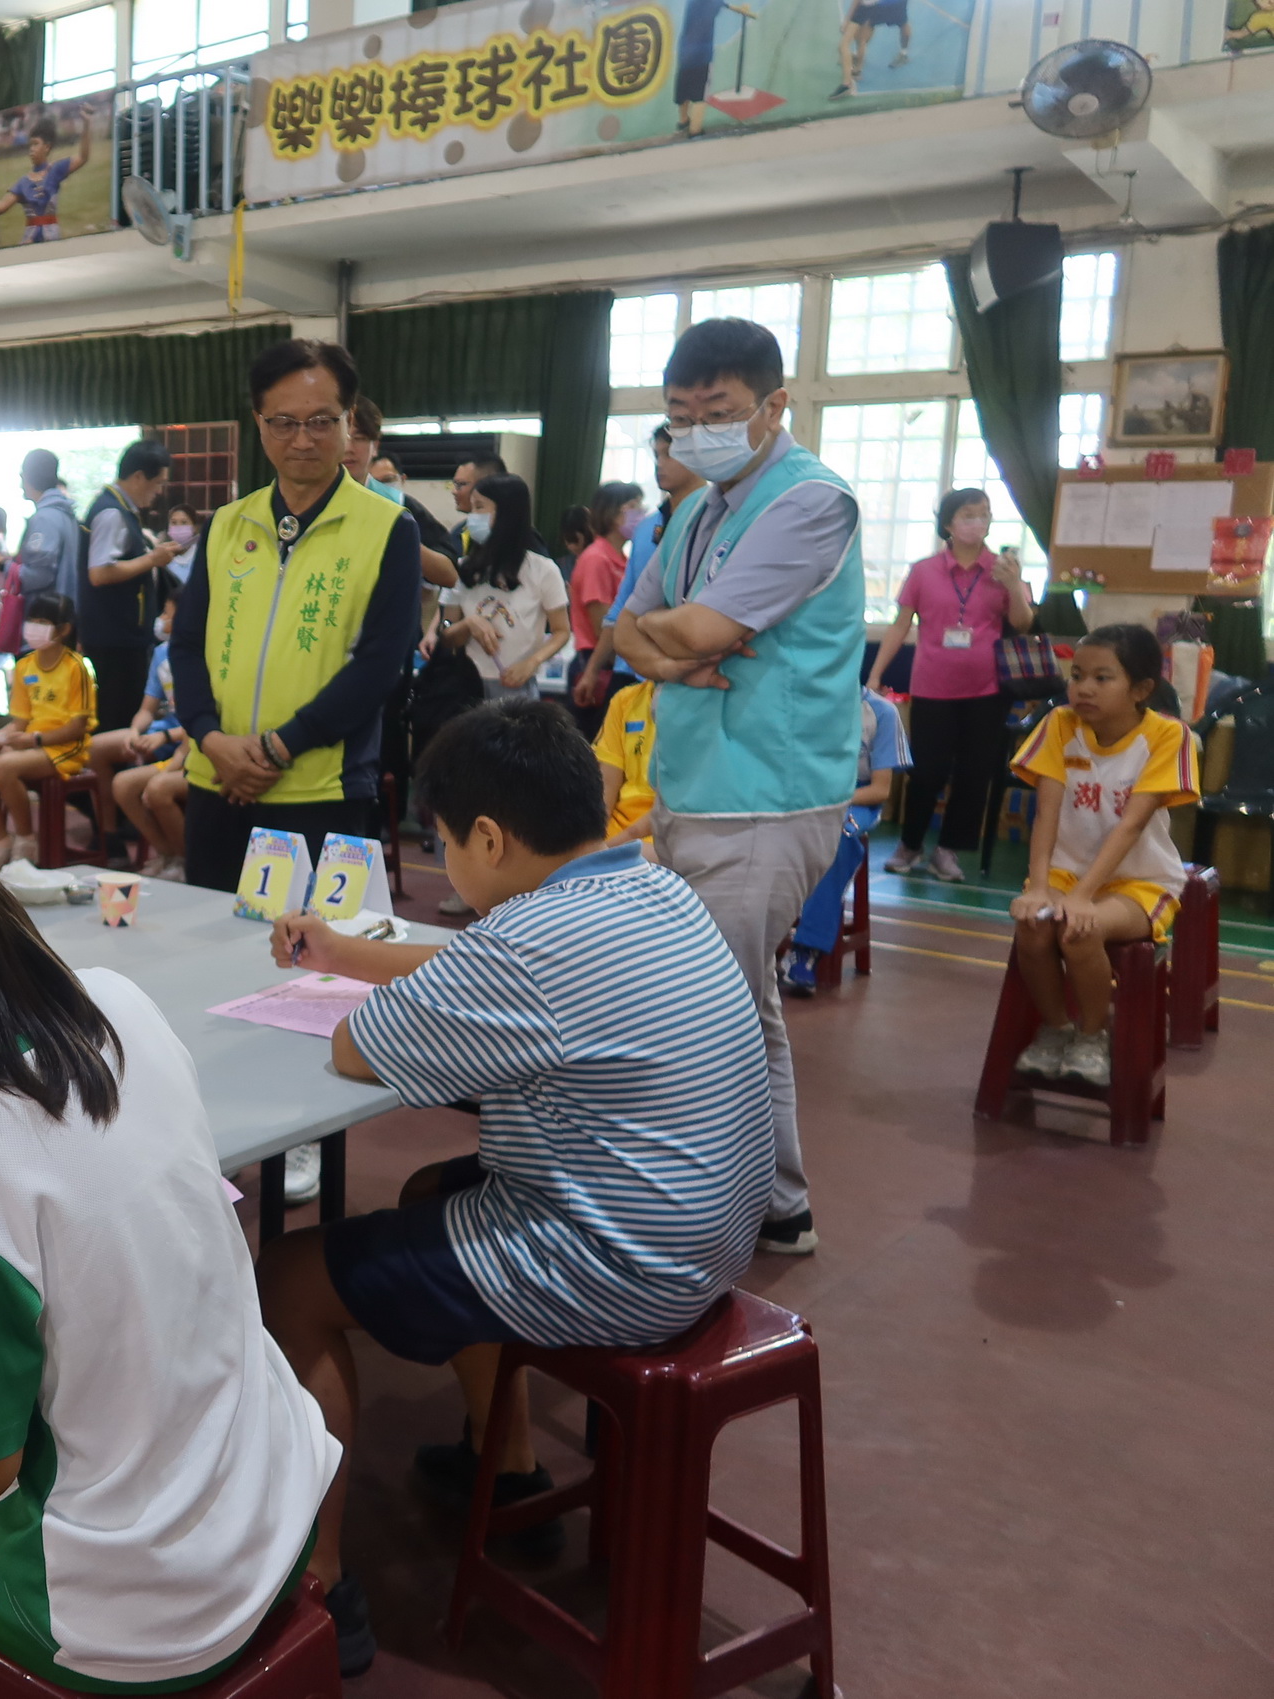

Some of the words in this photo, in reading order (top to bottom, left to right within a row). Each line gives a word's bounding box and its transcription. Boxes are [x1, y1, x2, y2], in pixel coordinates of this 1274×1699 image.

[272, 13, 663, 152] 樂樂棒球社團
[296, 572, 326, 653] 林世賢
[324, 556, 351, 628] 彰化市長
[256, 864, 272, 896] 1
[326, 873, 347, 904] 2
